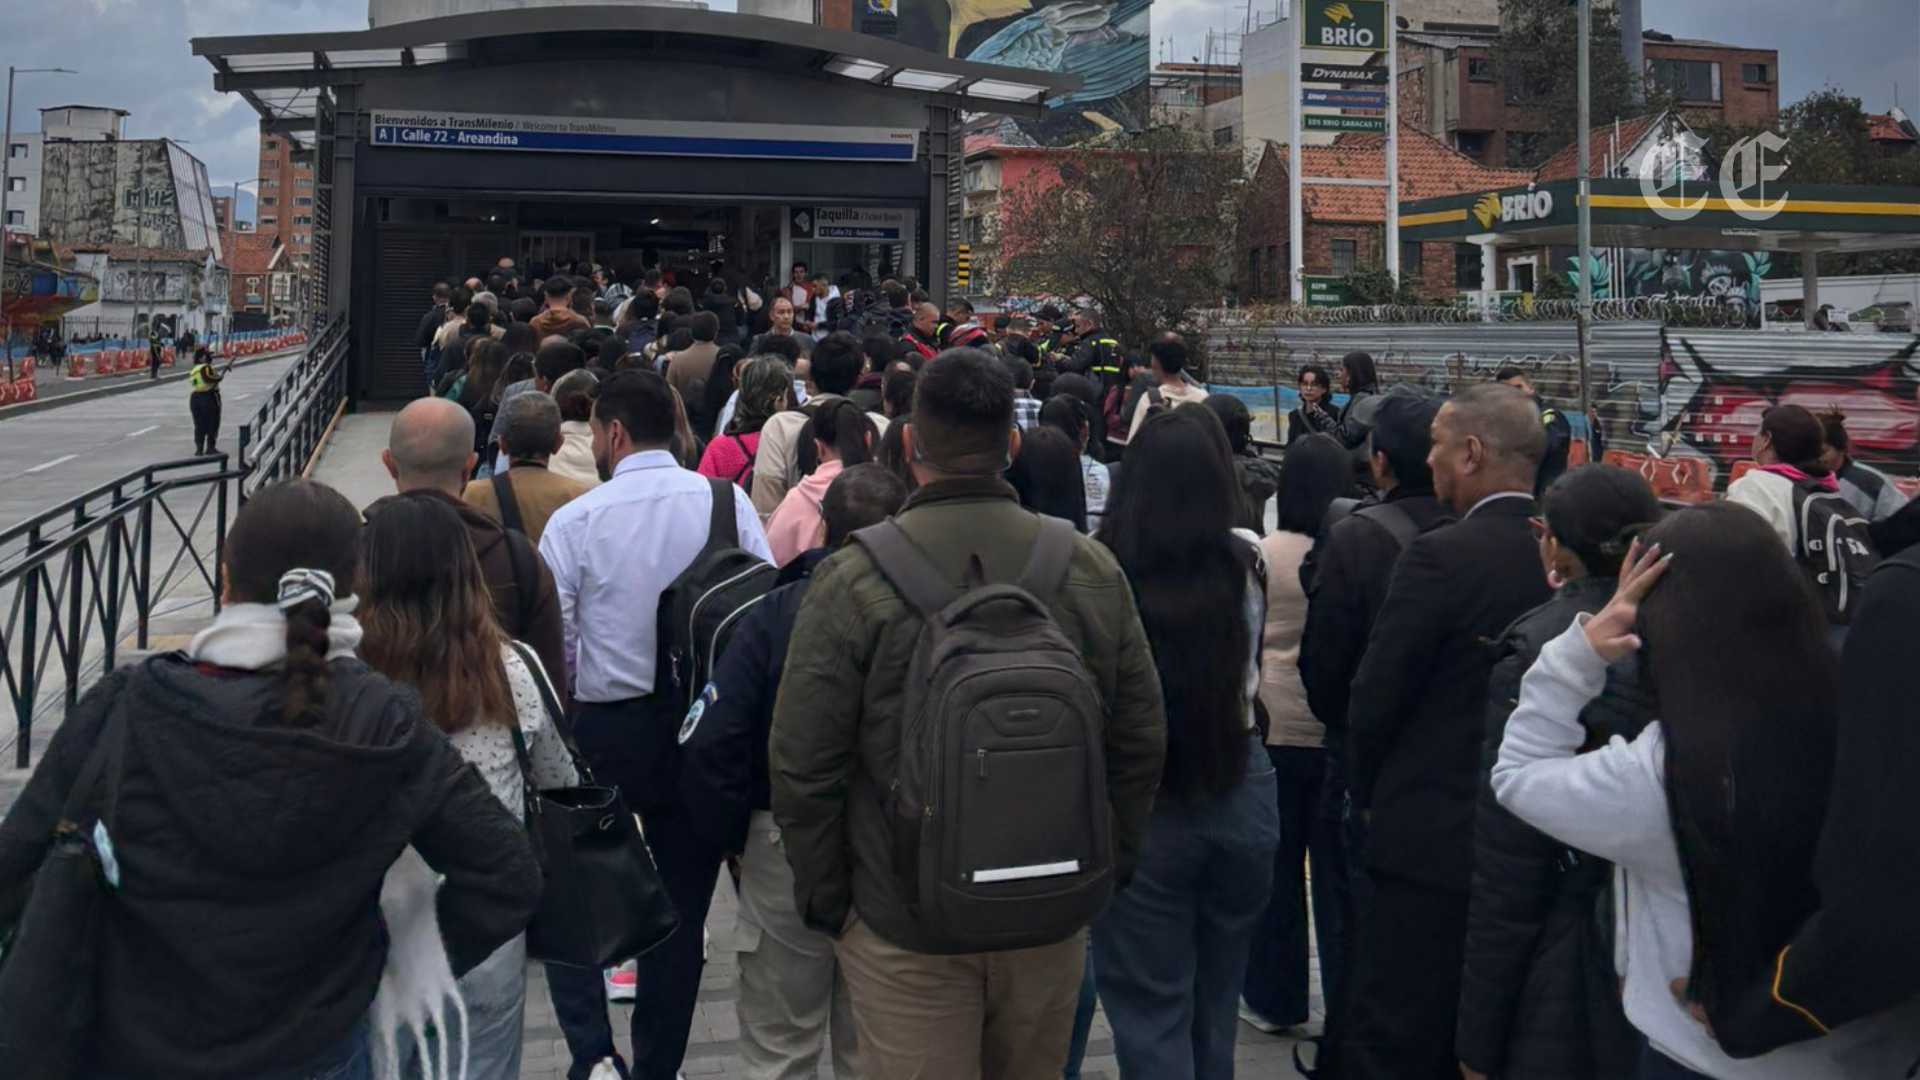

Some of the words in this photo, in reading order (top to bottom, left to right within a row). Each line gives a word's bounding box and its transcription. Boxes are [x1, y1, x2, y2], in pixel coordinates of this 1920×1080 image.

[1321, 22, 1374, 46] BRÍO
[1312, 68, 1376, 80] DYNAMAX
[375, 114, 438, 127] Bienvenidos
[440, 119, 447, 127] a
[448, 117, 514, 130] TransMilenio
[523, 121, 558, 131] Welcome
[569, 123, 618, 134] TransMilenio
[379, 128, 388, 140] A
[402, 129, 431, 141] Calle
[434, 130, 448, 142] 72
[458, 131, 519, 145] Areandina
[1501, 182, 1553, 222] BRÍO
[814, 207, 859, 222] Taquilla
